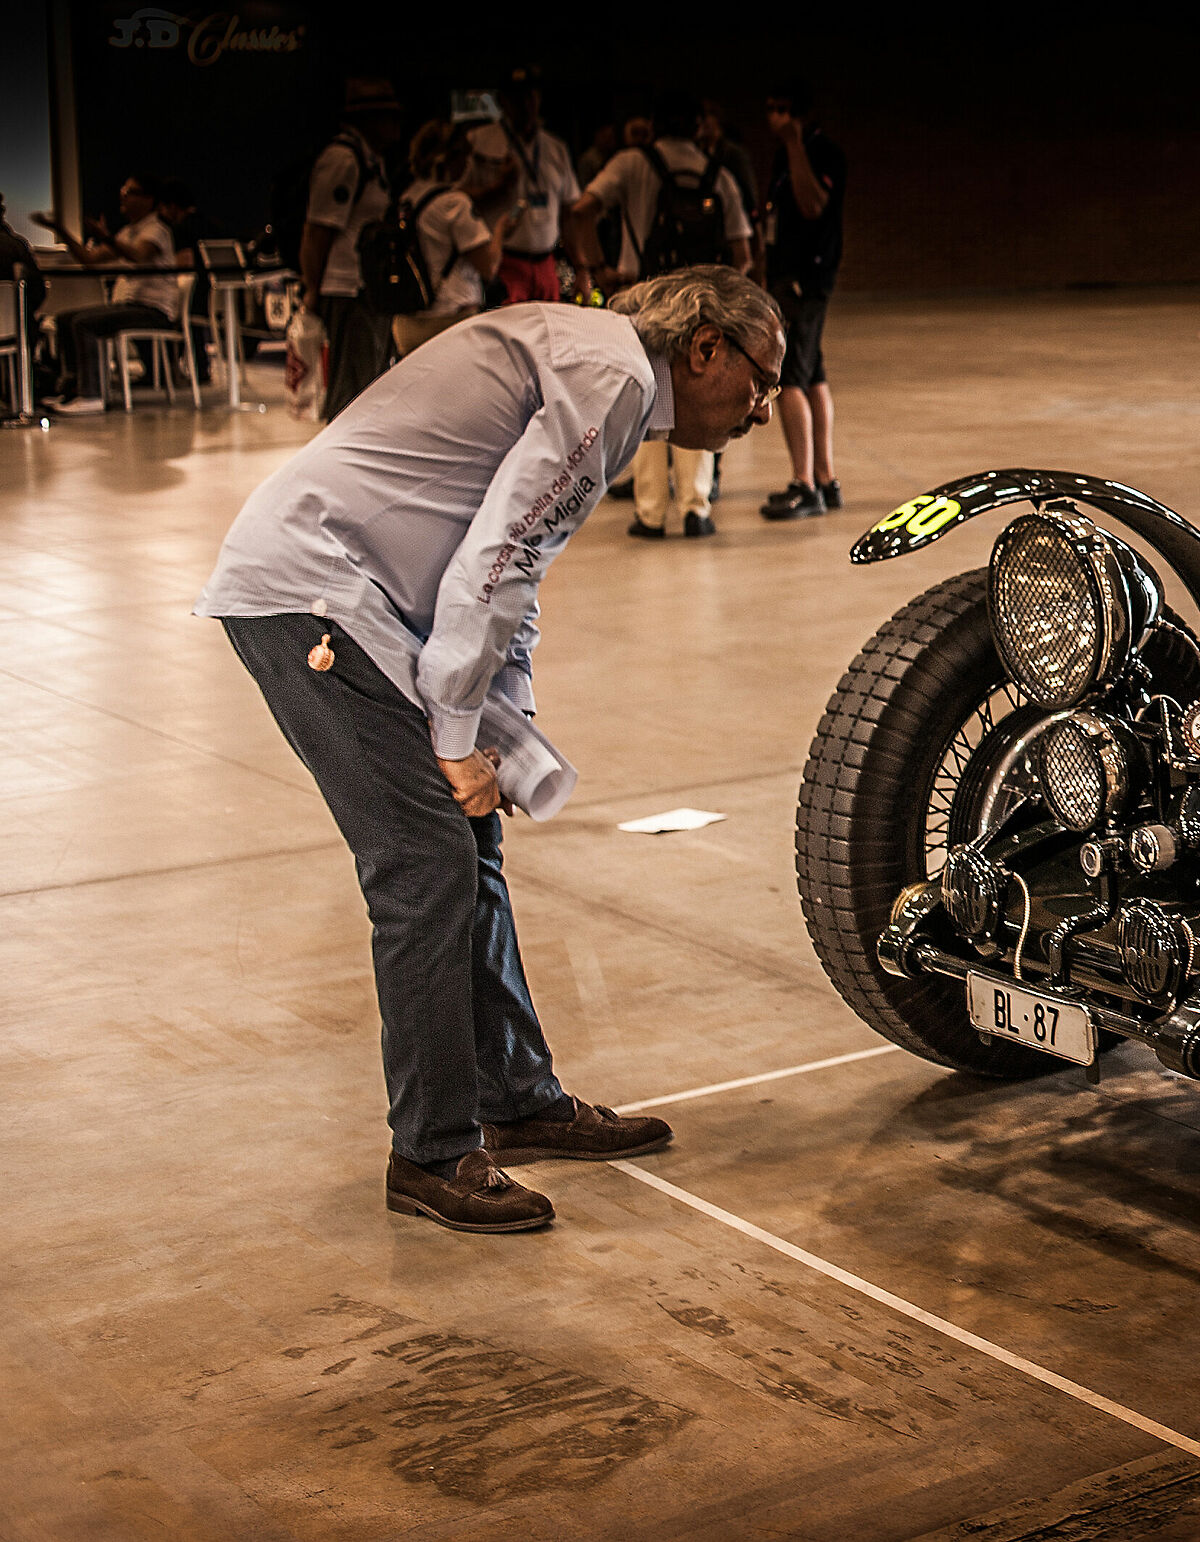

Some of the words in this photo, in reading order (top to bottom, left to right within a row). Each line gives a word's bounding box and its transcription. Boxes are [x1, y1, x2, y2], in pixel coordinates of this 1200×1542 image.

[187, 13, 298, 68] Classics
[543, 475, 597, 534] Miglia
[477, 582, 494, 604] La
[487, 542, 518, 584] corsa
[527, 493, 554, 527] bella
[552, 472, 574, 497] del
[993, 988, 1020, 1035] BL
[1033, 1002, 1060, 1046] 87
